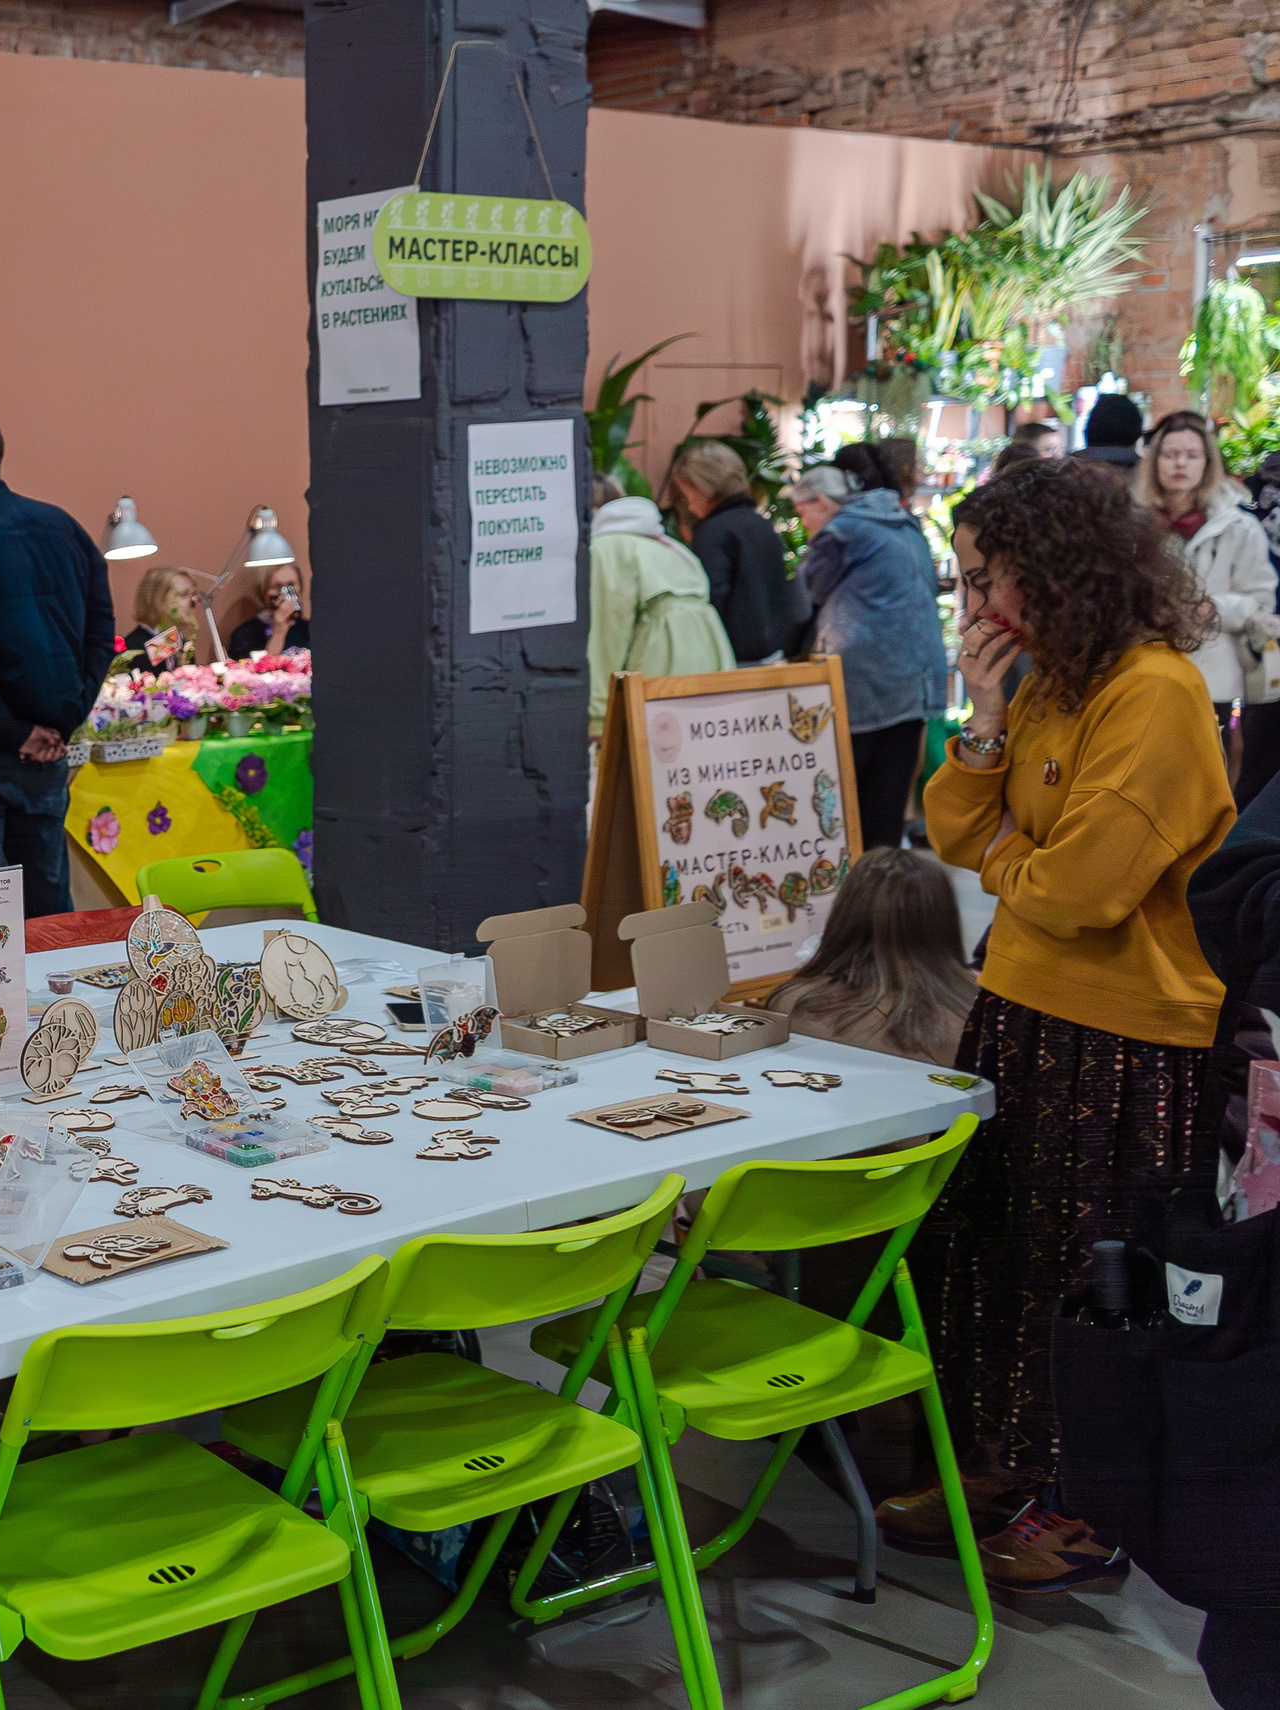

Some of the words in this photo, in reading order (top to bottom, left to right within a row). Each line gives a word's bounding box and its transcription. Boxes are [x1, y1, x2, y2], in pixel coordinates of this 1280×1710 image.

[323, 213, 361, 234] МОРЯ
[322, 244, 366, 267] БУДЕМ
[388, 235, 580, 269] МАСТЕР-КЛАССЫ
[320, 274, 385, 298] КУПАТЬСЯ
[321, 311, 331, 330] В
[333, 302, 409, 328] РАСТЕНИЯХ
[473, 454, 568, 477] НЕВОЗМОЖНО
[475, 485, 547, 506] ПЕРЕСТАТЬ
[477, 516, 545, 538] ПОКУПАТЬ
[475, 546, 544, 568] РАСТЕНИЯ
[689, 713, 783, 741] МОЗАИКА
[667, 767, 692, 788] ИЗ
[698, 752, 817, 784] МИНЕРАЛОВ
[675, 838, 827, 876] МАСТЕР-КЛАСС
